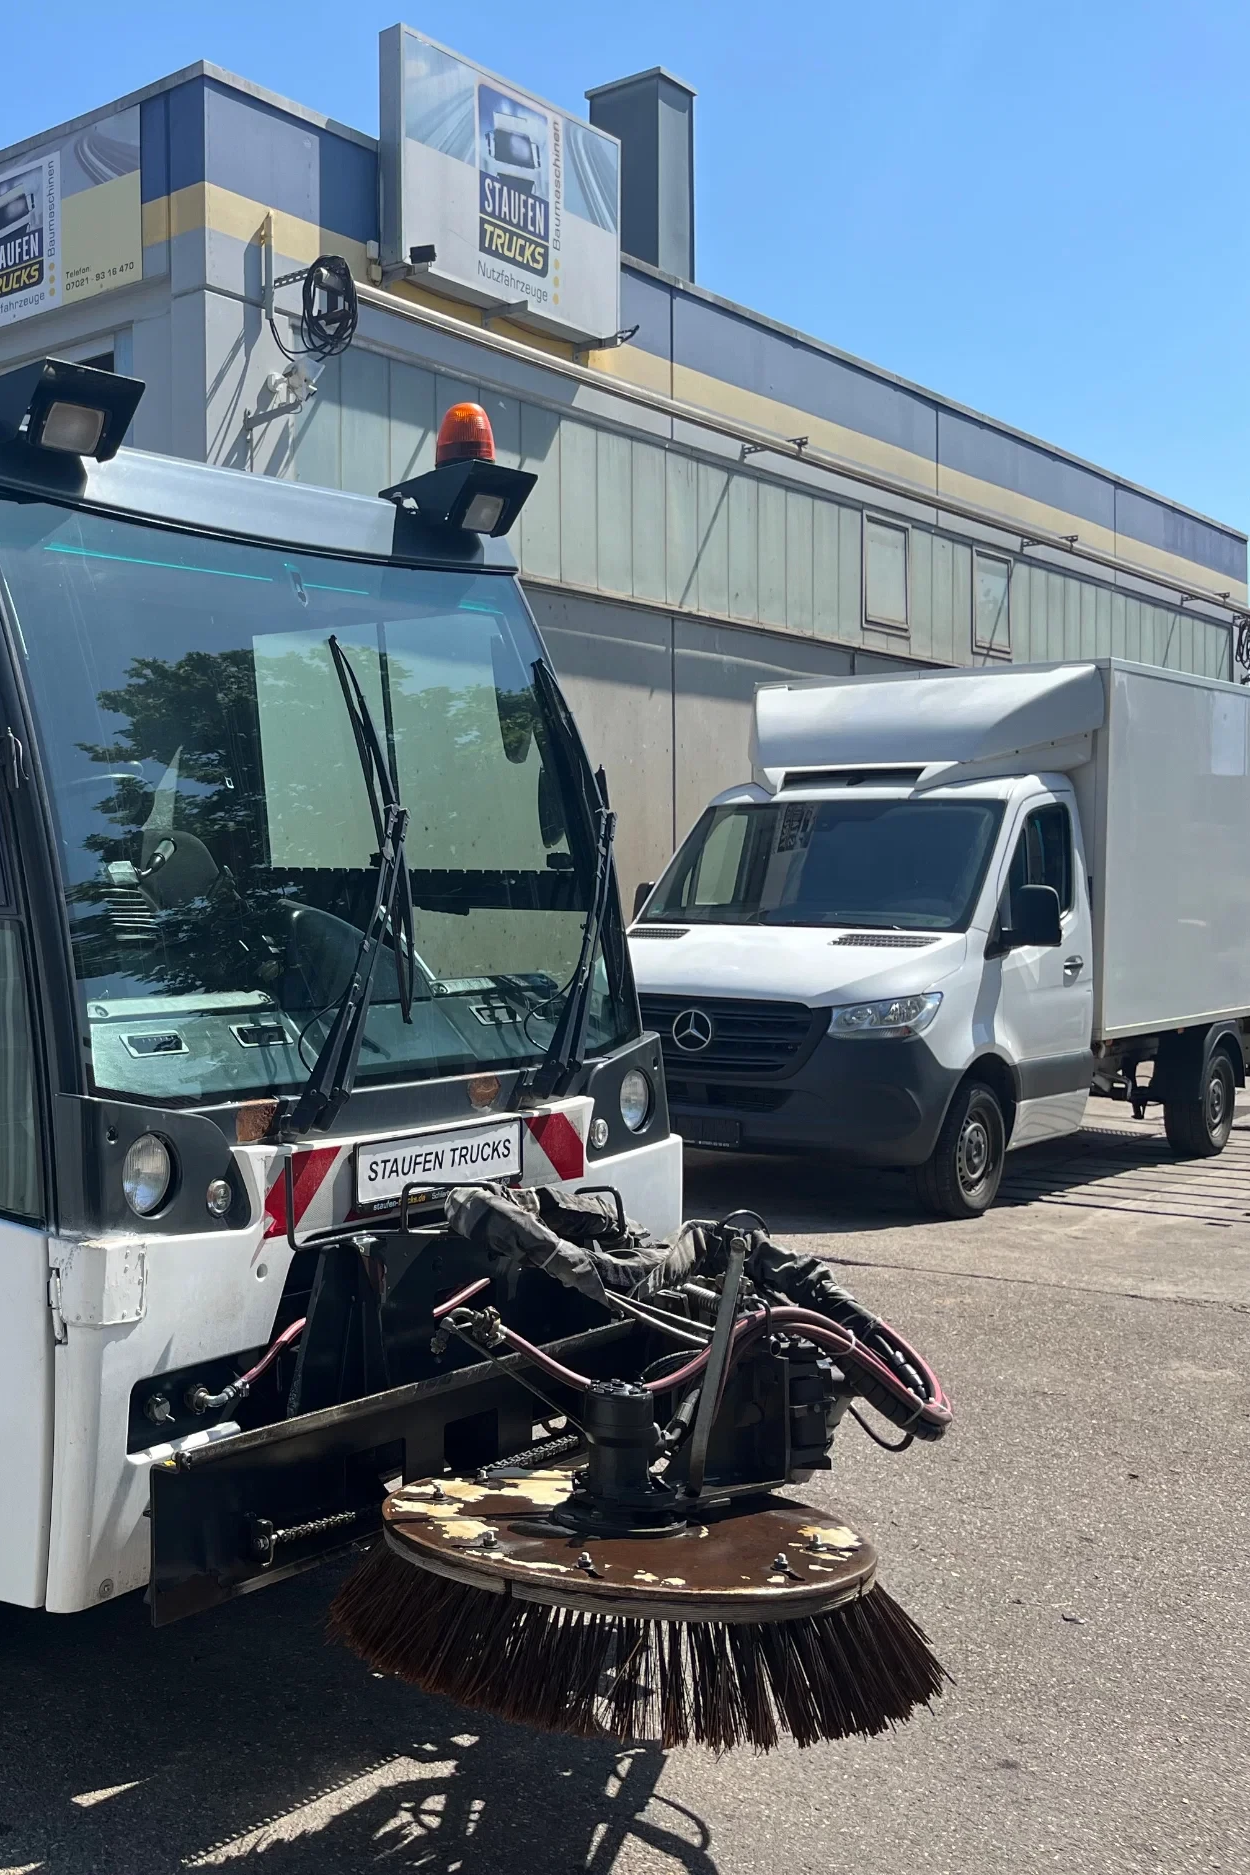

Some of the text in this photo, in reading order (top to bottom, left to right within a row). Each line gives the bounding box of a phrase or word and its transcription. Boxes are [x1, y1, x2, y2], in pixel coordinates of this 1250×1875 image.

[484, 178, 545, 237] STAUFEN
[552, 120, 561, 251] Baumaschinen
[483, 223, 545, 270] TRUCKS
[65, 266, 92, 279] Telefon:
[65, 277, 89, 291] 07021
[119, 261, 134, 273] 470
[477, 259, 548, 303] Nutzfahrzeuge
[368, 1139, 511, 1181] STAUFEN TRUCKS
